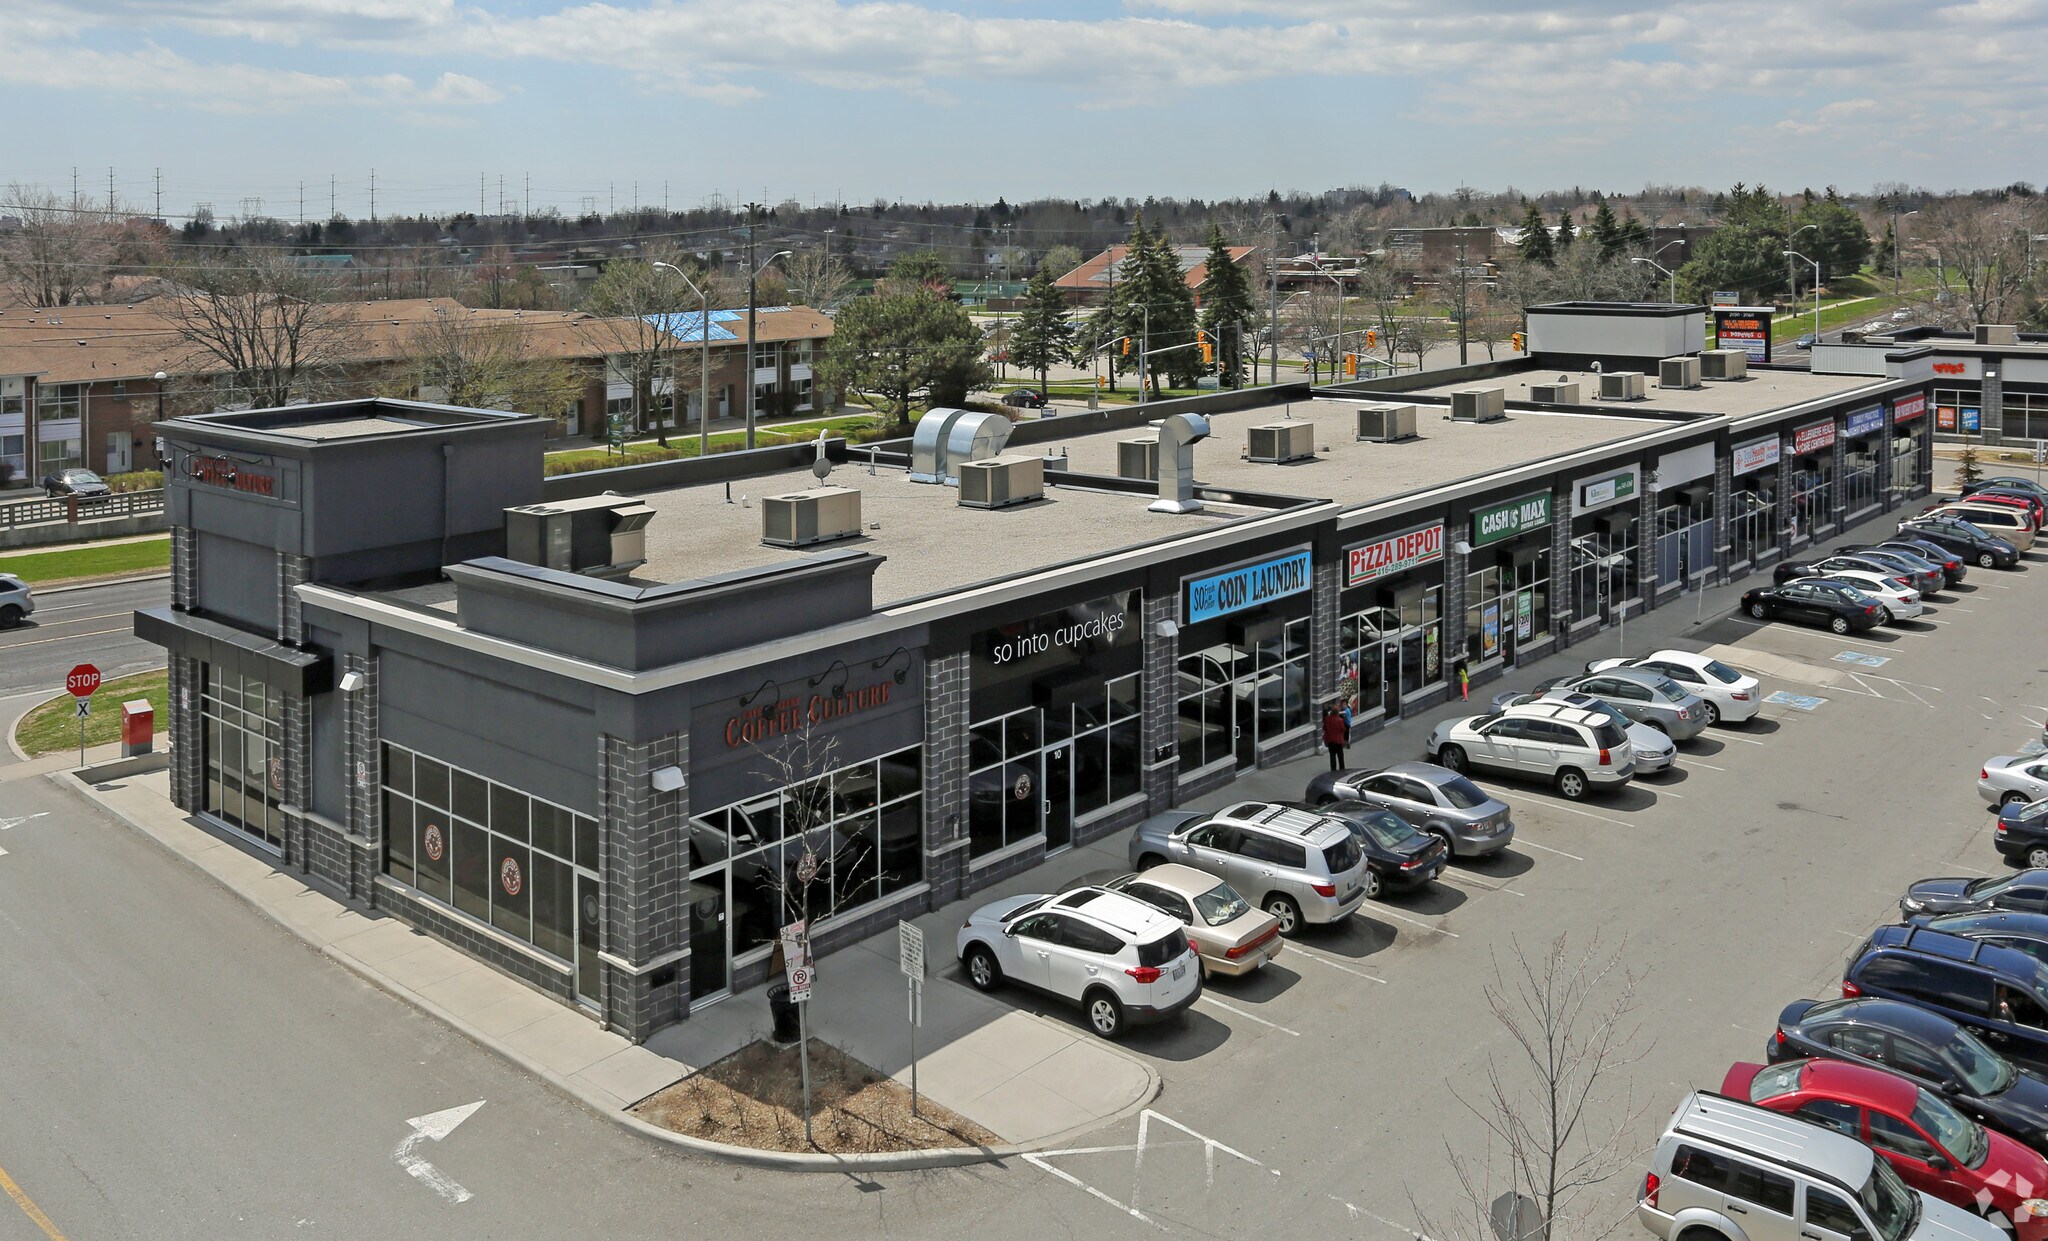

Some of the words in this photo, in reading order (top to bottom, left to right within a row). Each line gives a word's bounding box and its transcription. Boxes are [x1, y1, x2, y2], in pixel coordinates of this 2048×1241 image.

[1482, 510, 1508, 535] CASH
[1521, 499, 1546, 523] MAX
[1396, 526, 1442, 561] DEPOT
[1376, 556, 1419, 576] 416-289-9711
[1194, 586, 1205, 612] SO
[1217, 573, 1248, 611] COIN
[1252, 557, 1307, 601] LAUNDRY
[993, 643, 1013, 665] so
[1017, 633, 1049, 658] into
[1054, 611, 1125, 648] cupcakes
[68, 673, 99, 688] STOP
[726, 708, 802, 748] COFFEE
[809, 681, 892, 724] CULTURE
[1053, 749, 1062, 760] 10
